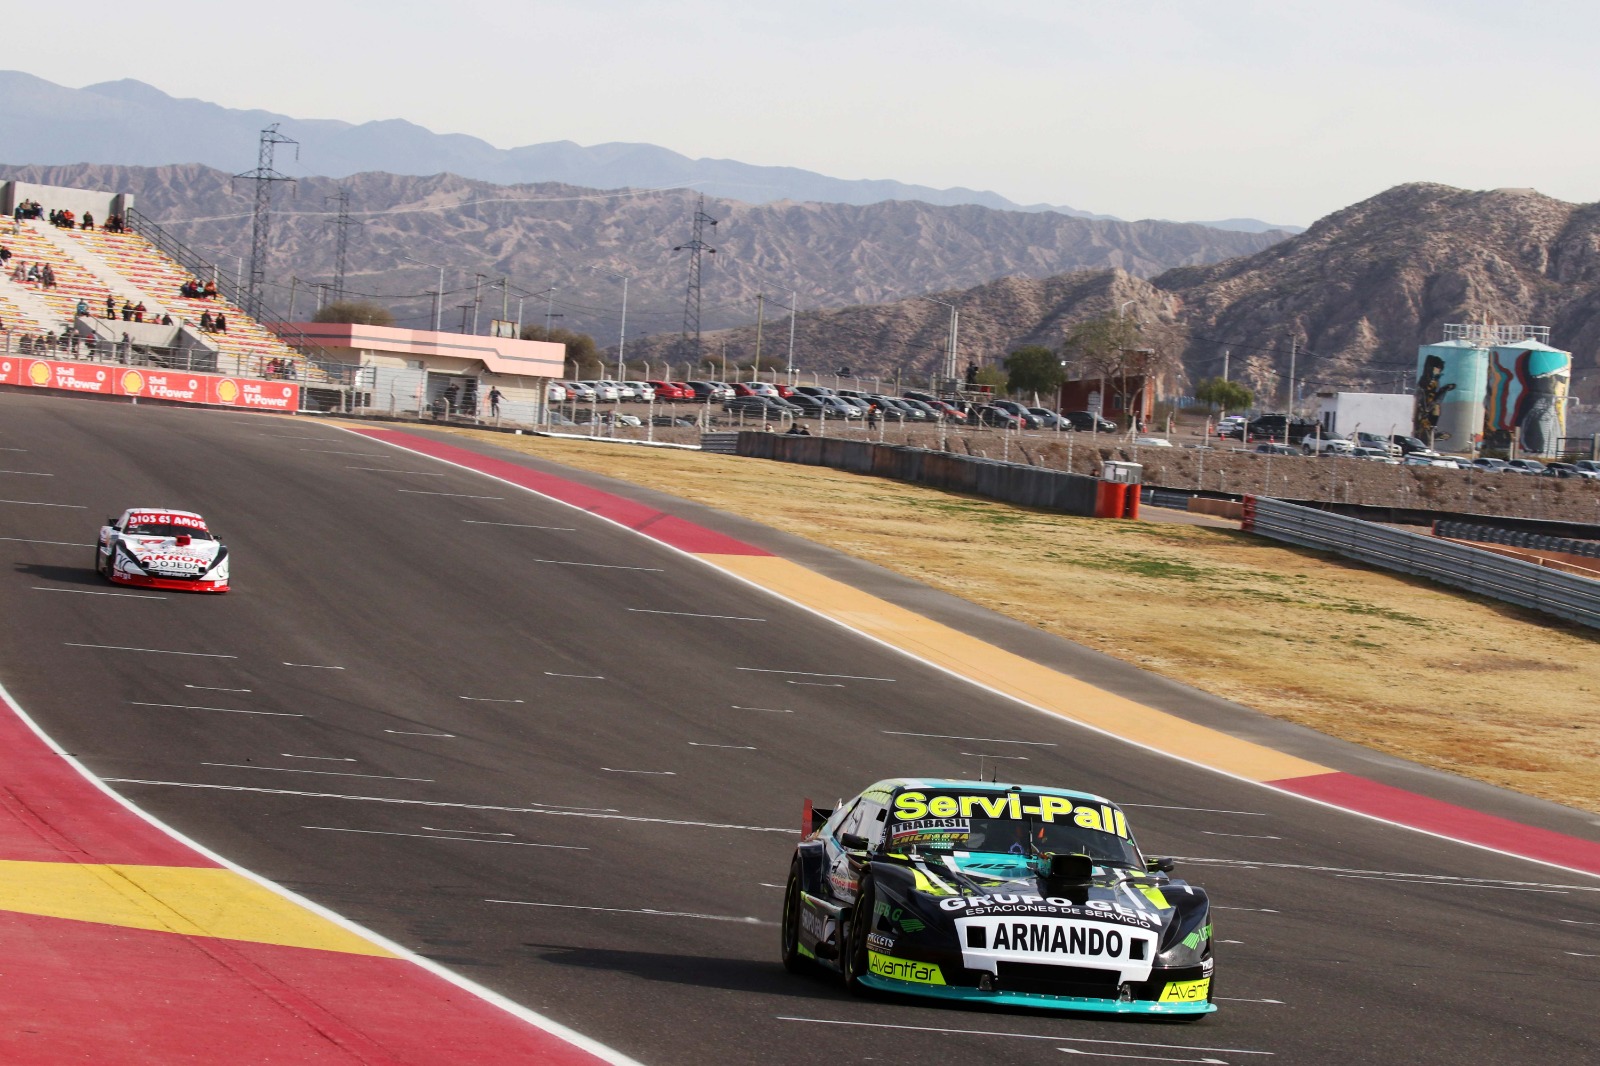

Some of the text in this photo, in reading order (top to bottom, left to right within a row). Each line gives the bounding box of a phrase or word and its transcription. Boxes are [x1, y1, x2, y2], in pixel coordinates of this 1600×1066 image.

[56, 367, 75, 376] Shell
[56, 375, 102, 390] V-Power
[148, 376, 167, 385] Shell
[149, 385, 194, 398] V-Power
[243, 384, 261, 393] Shell
[243, 393, 288, 407] V-Power
[129, 515, 207, 530] DIOS ES AMOR
[140, 554, 208, 566] AKRON
[160, 561, 199, 570] OJEDA
[893, 791, 1128, 840] Servi-Pall
[893, 818, 969, 833] TRABASIL
[939, 893, 1163, 927] GRUPO GEN
[965, 904, 1152, 928] ESTACIONES DE SERVICIO
[992, 922, 1124, 958] ARMANDO
[871, 954, 936, 981] Avantfar
